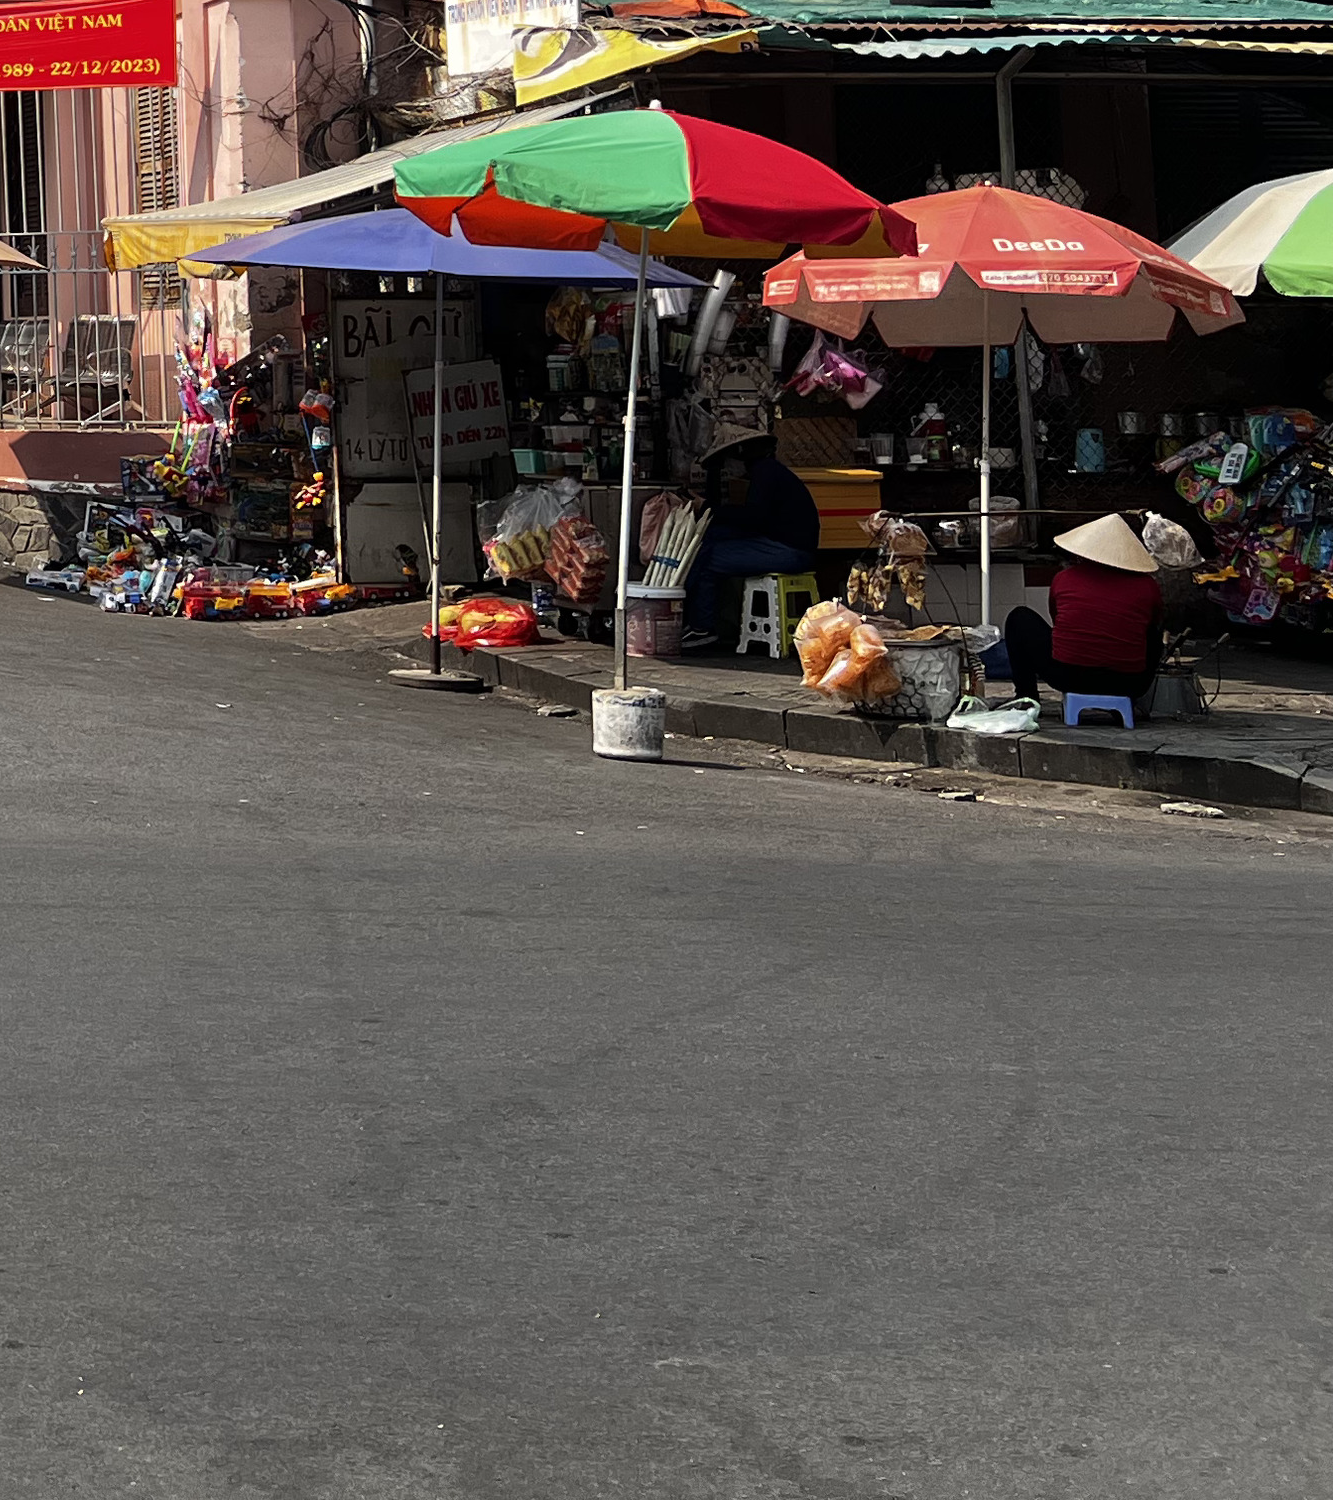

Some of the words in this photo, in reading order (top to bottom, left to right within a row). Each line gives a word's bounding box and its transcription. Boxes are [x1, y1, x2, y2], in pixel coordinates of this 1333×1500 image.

[35, 12, 77, 33] VIỆT
[82, 12, 124, 30] NAM
[50, 57, 161, 77] 22/12/2023)
[992, 238, 1084, 252] DeeDa
[481, 381, 502, 410] XE
[345, 438, 365, 461] 14
